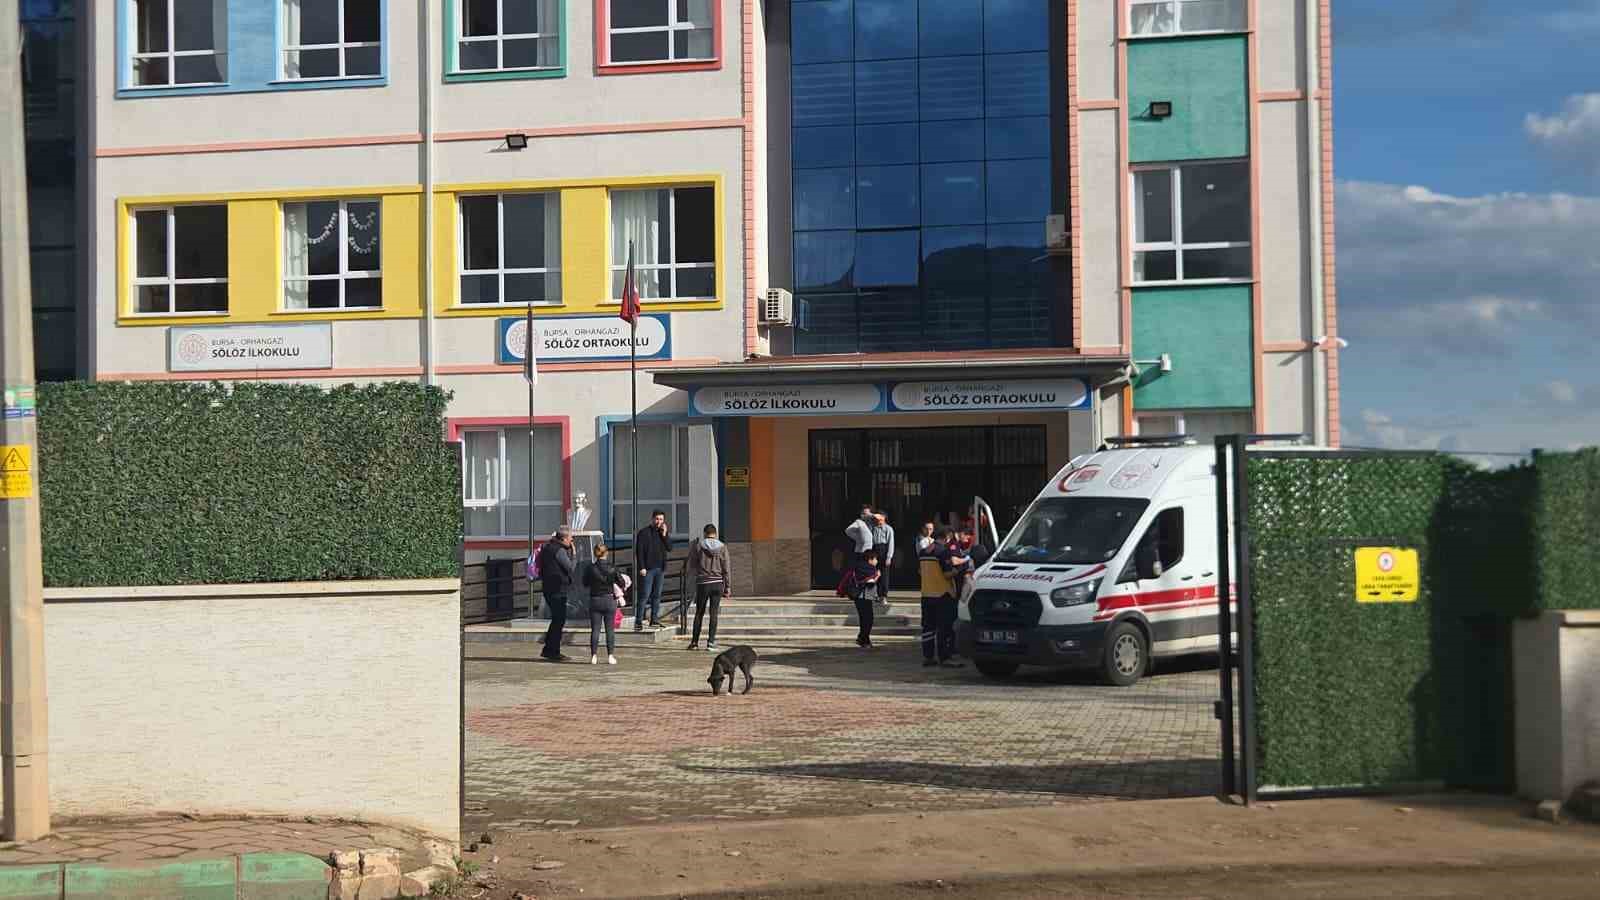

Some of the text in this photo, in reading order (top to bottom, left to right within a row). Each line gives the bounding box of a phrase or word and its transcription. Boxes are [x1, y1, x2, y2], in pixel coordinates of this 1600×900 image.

[544, 336, 649, 349] SÖLÖZ ORTAOKULU
[212, 347, 301, 358] SÖLÖZ İLKOKULU
[724, 397, 836, 409] SÖLÖZ İLKOKULU
[924, 392, 1056, 406] SÖLÖZ ORTAOKULU
